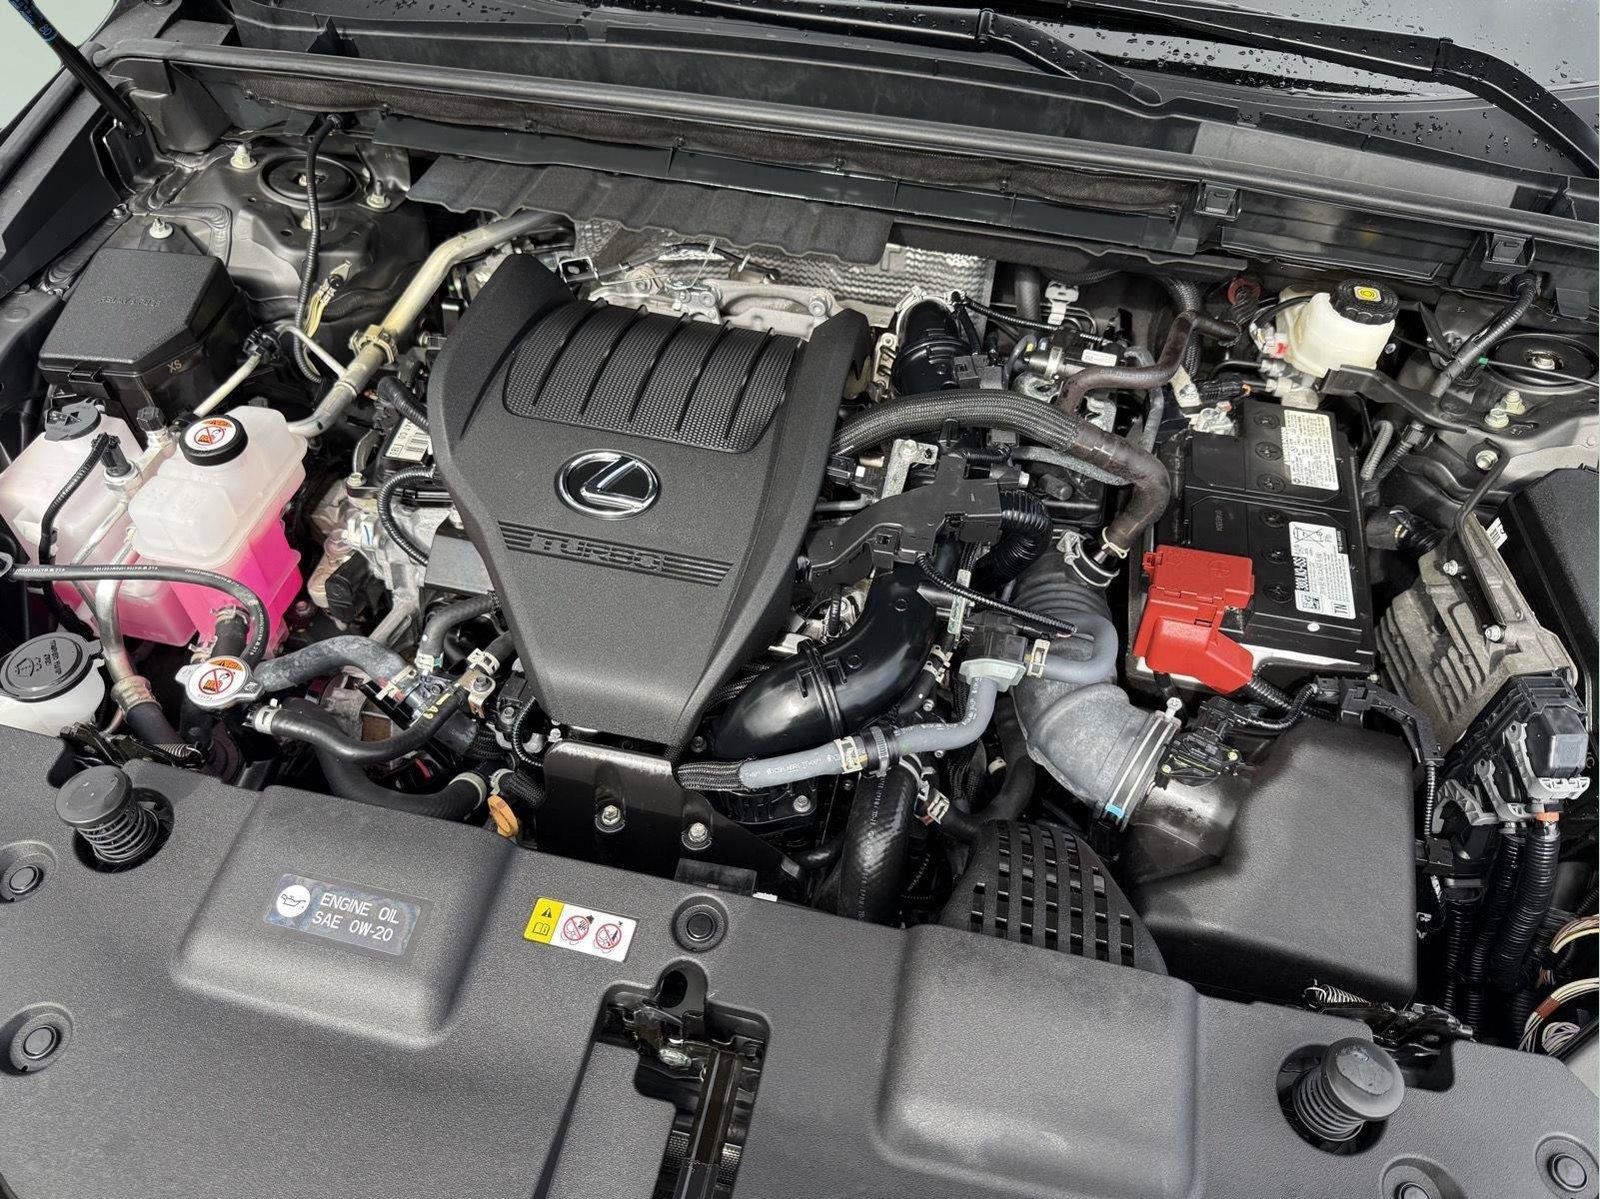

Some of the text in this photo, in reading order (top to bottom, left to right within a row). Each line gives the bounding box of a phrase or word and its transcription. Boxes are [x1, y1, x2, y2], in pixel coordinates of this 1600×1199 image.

[167, 359, 183, 374] XS
[531, 531, 664, 572] TURBO
[319, 892, 400, 924] ENGINE OIL
[312, 910, 394, 942] SAE 0W-20
